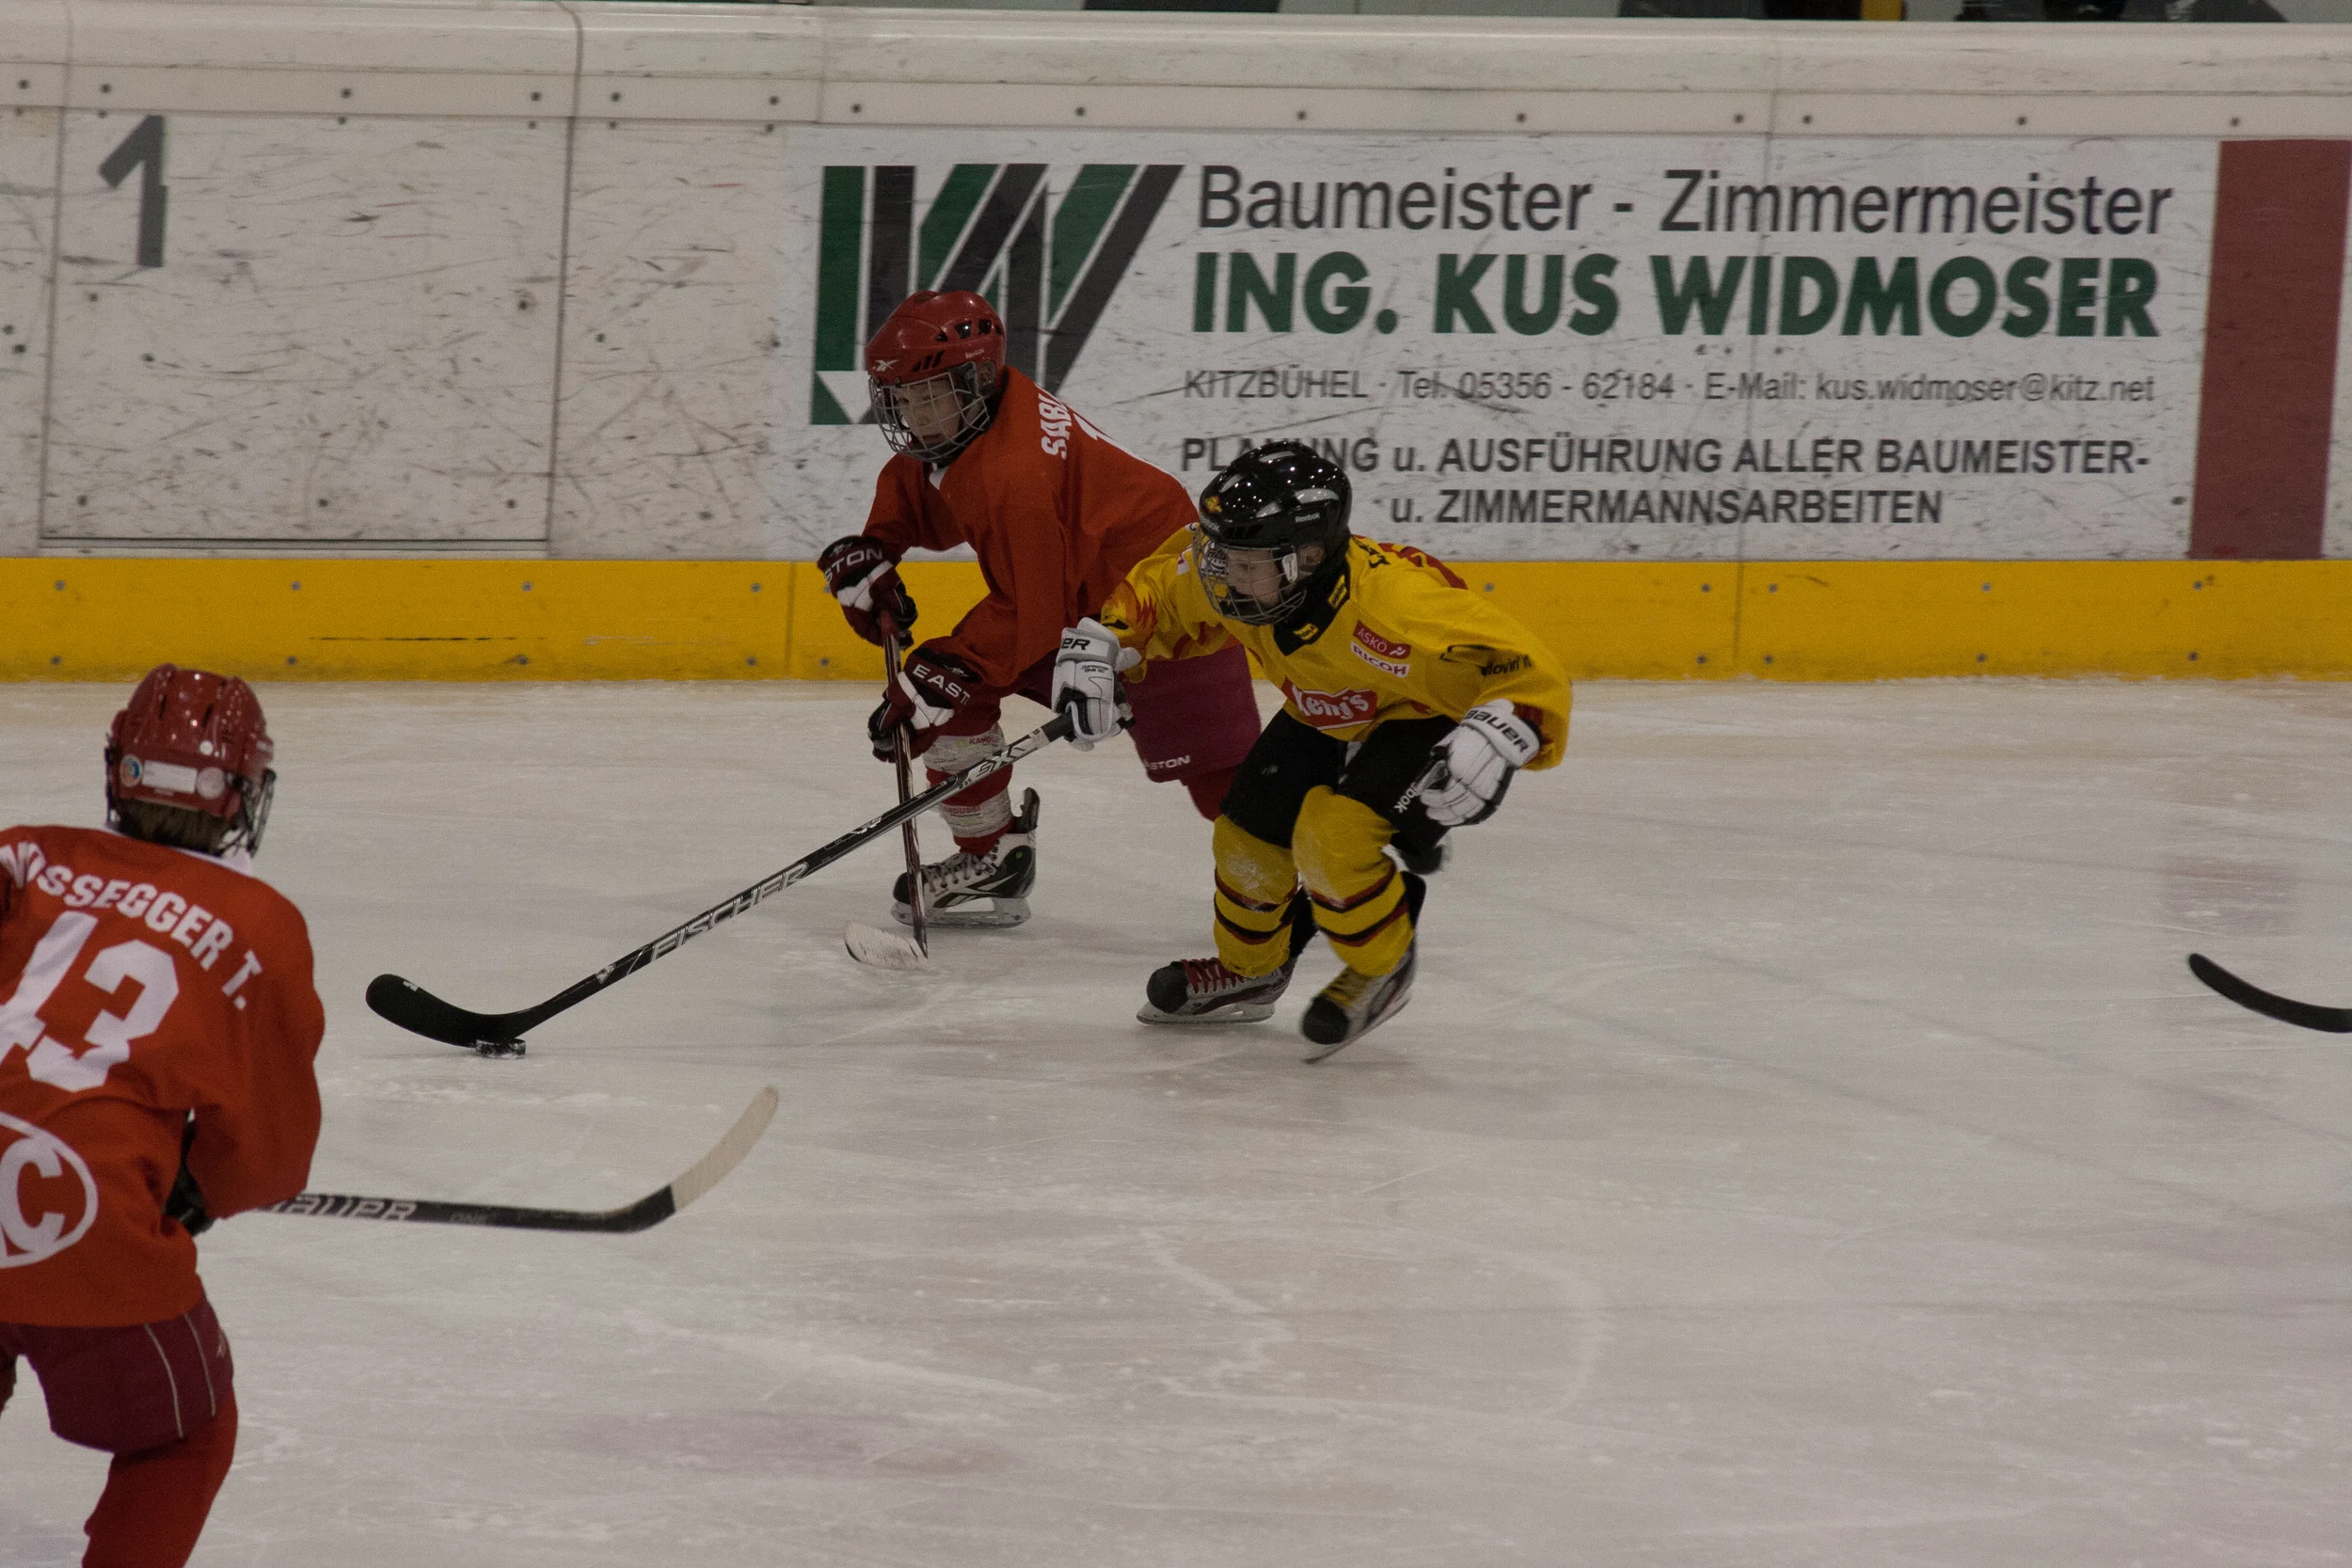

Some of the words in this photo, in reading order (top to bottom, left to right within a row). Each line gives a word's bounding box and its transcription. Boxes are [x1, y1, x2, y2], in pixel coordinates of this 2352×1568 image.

[98, 115, 167, 268] 1
[1198, 165, 1594, 231] Baumeister
[1660, 169, 2173, 235] Zimmermeister
[1191, 250, 1400, 335] ING.
[1432, 253, 1621, 337] KUS
[1648, 255, 2161, 339] WIDMOSER
[1183, 363, 1369, 399] KITZBÜHEL
[1396, 370, 1448, 400] Tel.
[1458, 372, 1552, 401] 05356
[1581, 372, 1676, 401] 62184
[1705, 372, 1807, 401] E-Mail:
[1815, 372, 2156, 402] kus.widmoser@kitz.net
[1181, 437, 1380, 472] PLNG
[1393, 447, 1426, 472] u.
[1436, 431, 1724, 472] AUSFÜHRUNG
[1732, 438, 1865, 473] ALLER
[1876, 439, 2151, 474] BAUMEISTER-
[1295, 512, 1321, 524] Reebok
[1390, 498, 1424, 523] u.
[1434, 488, 1944, 524] ZIMMERMANNSARBEITEN
[1352, 644, 1407, 676] RICOH
[1356, 627, 1389, 653] ASKÖ
[1464, 708, 1531, 752] BAUER
[649, 860, 810, 962] FISCHER
